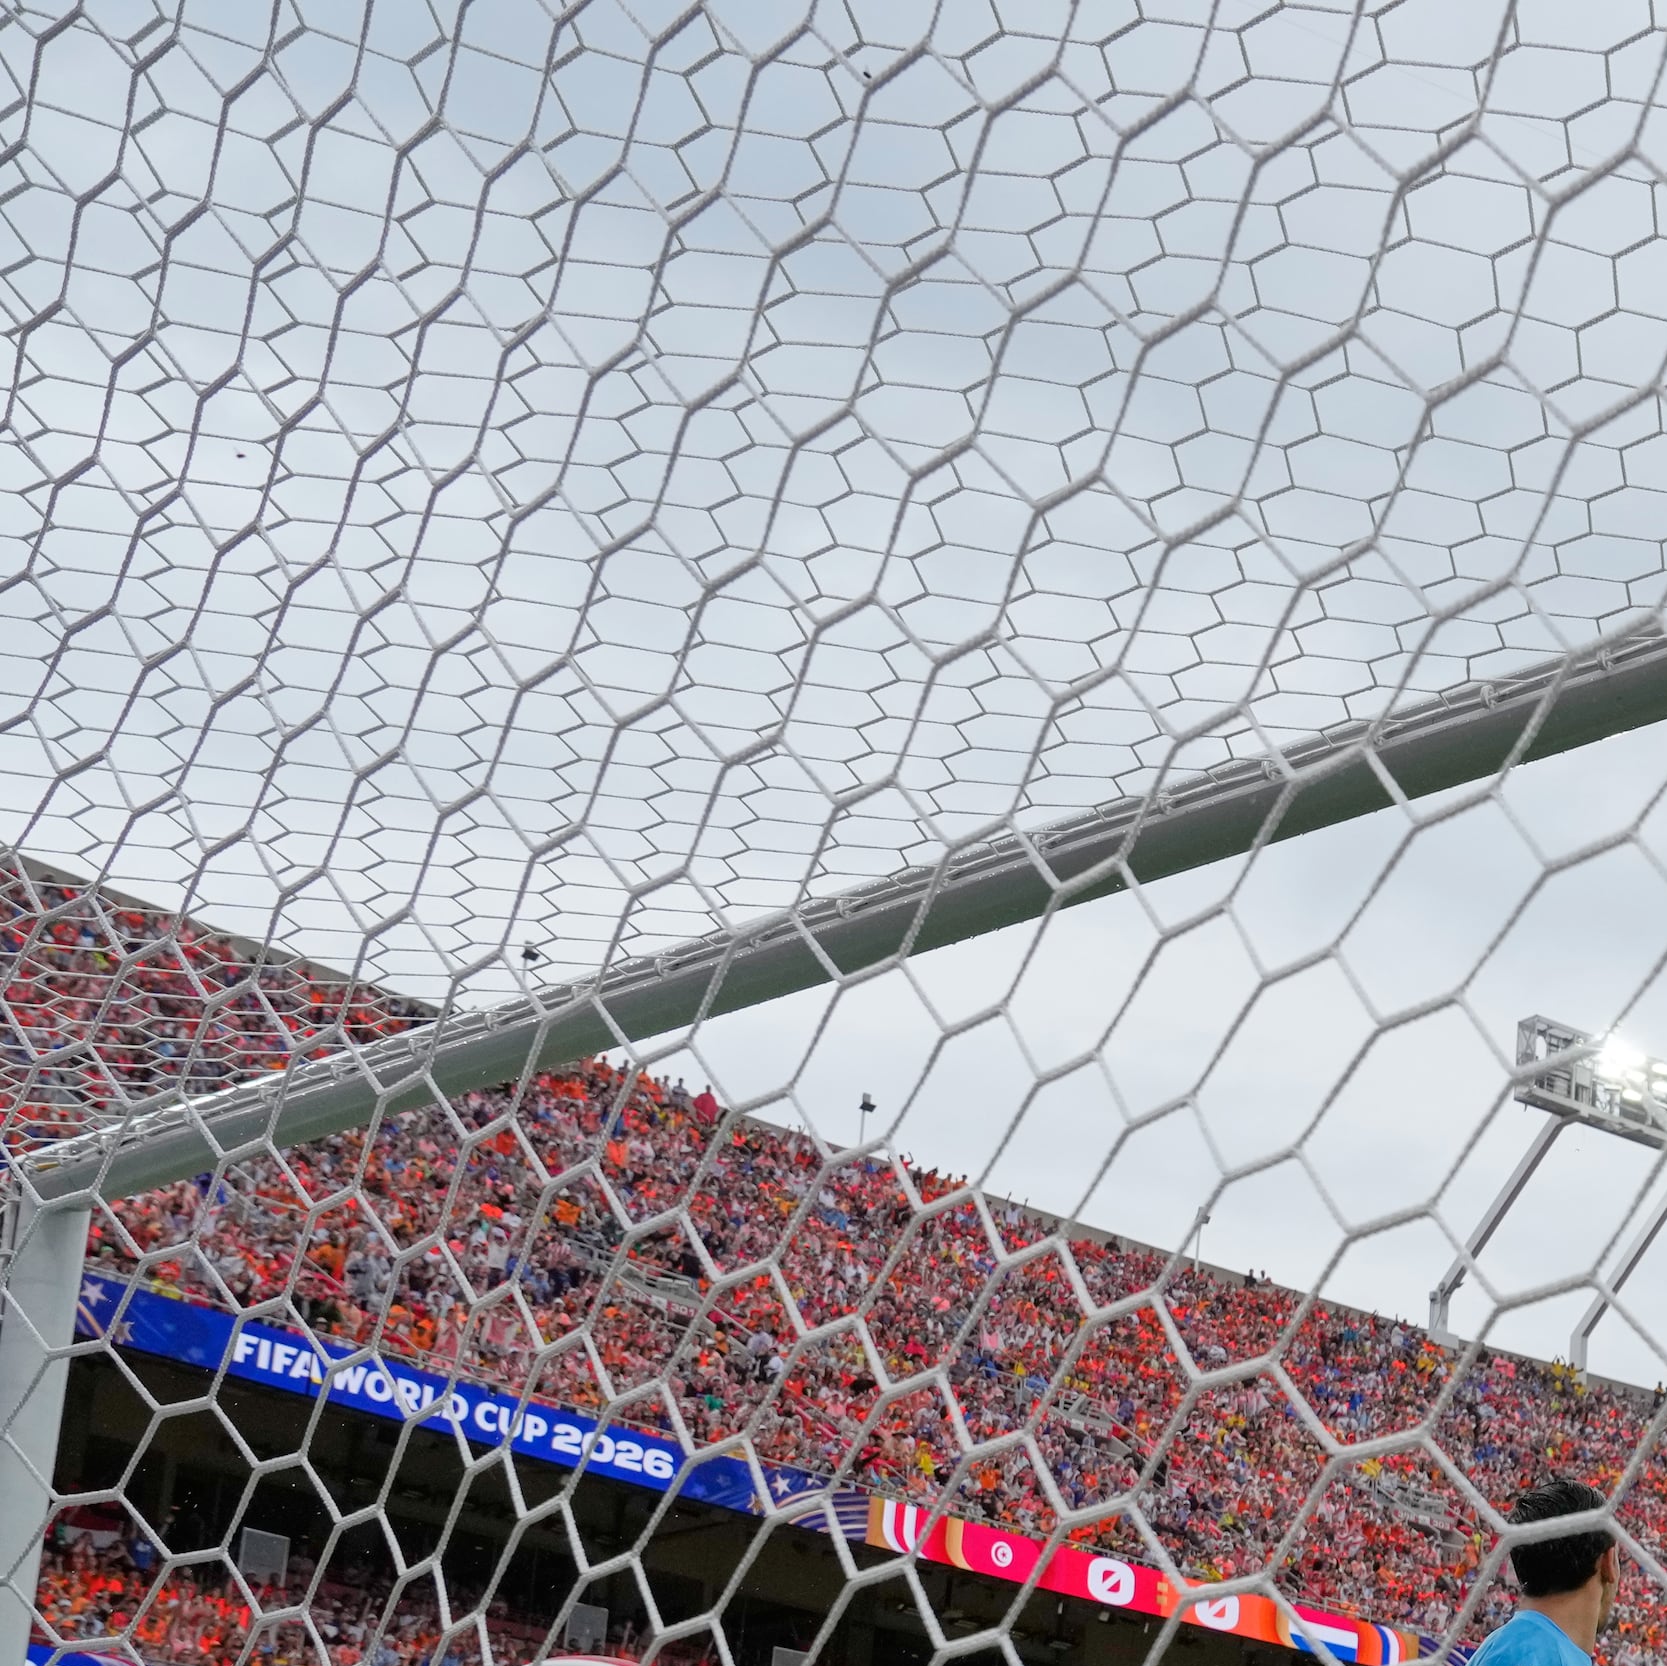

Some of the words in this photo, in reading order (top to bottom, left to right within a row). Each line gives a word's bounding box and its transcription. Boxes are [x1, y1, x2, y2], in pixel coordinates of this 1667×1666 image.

[232, 1332, 323, 1384] FIFA
[330, 1358, 469, 1422] WORLD
[474, 1401, 548, 1443] CUP
[551, 1423, 674, 1480] 2026
